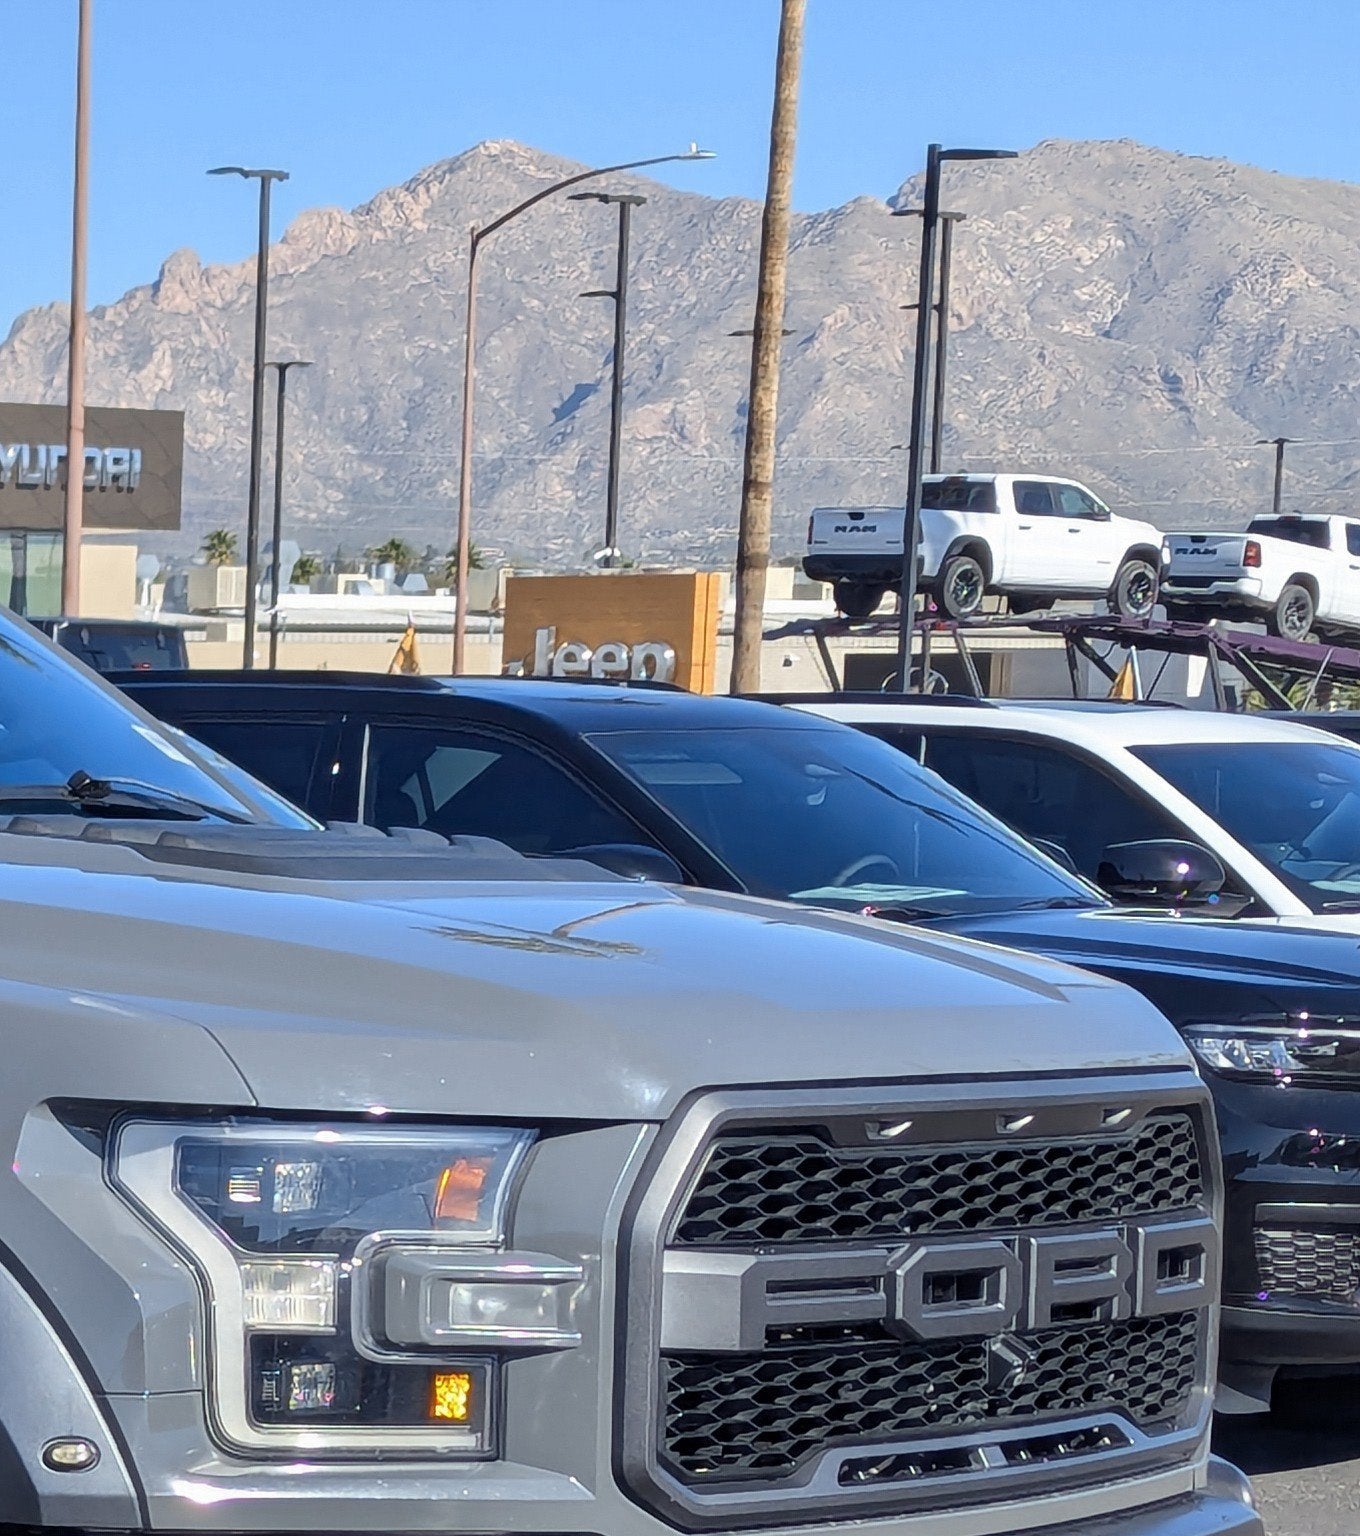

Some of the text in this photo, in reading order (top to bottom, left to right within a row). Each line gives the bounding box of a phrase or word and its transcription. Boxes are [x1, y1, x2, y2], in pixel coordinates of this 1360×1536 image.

[1174, 547, 1218, 555] RAM
[507, 626, 676, 681] Jeep
[738, 1217, 1217, 1350] FORD
